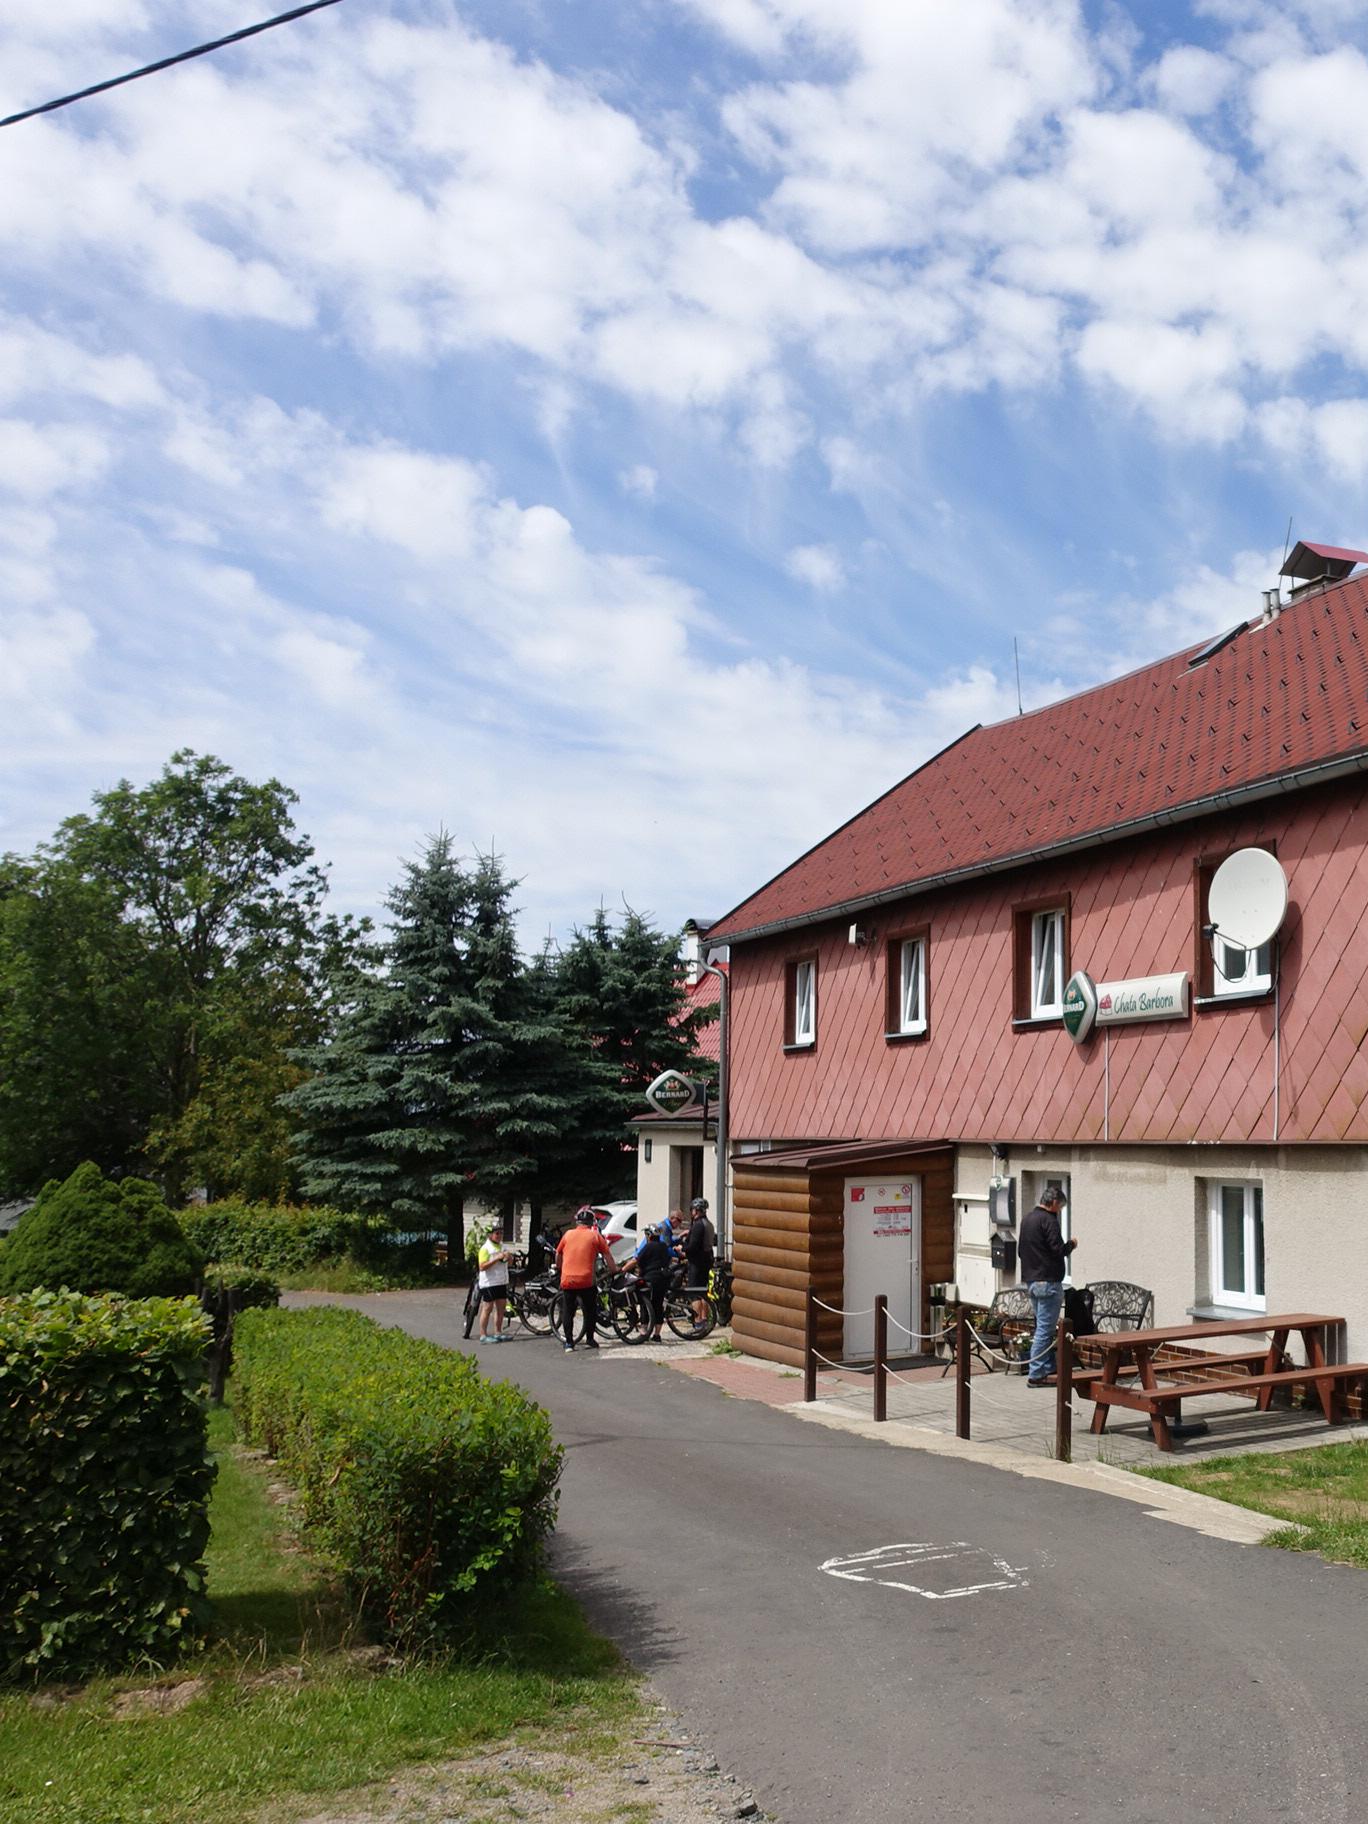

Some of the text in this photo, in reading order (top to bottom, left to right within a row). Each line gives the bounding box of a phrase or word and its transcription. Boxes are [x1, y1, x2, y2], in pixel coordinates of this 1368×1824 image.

[1114, 987, 1174, 1014] Chata Barbora
[655, 1090, 689, 1099] BERNARD
